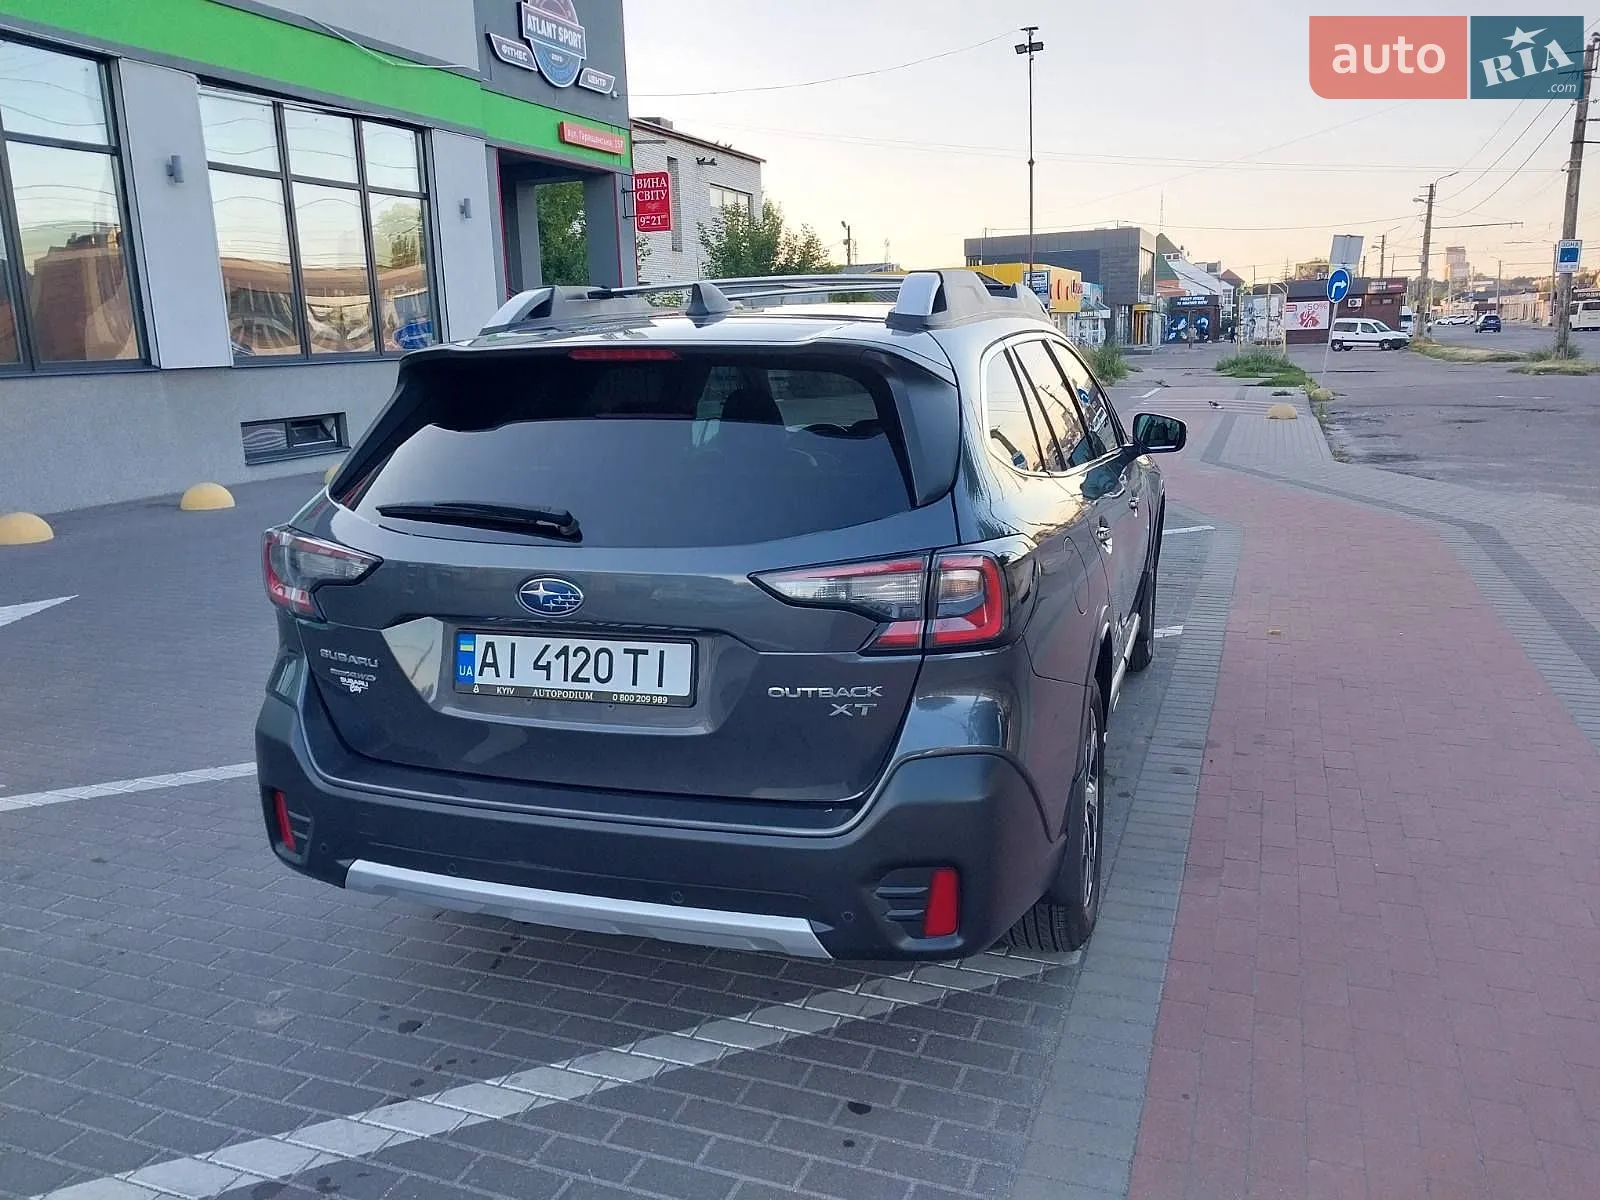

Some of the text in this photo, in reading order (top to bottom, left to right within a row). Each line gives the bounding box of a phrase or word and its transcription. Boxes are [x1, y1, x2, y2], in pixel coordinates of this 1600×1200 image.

[527, 13, 582, 49] ATLANT SPORT
[636, 177, 667, 189] ВИНА
[636, 189, 667, 201] СВІТУ
[320, 649, 379, 668] SUBARU
[478, 641, 665, 688] AI 4120 TI
[459, 665, 474, 677] UA
[340, 676, 369, 687] SUBARU
[496, 686, 515, 695] KYIV
[532, 688, 594, 701] AUTOPODIUM
[767, 686, 884, 698] OUTBACK
[612, 693, 668, 704] 0 800 209 989
[829, 703, 878, 717] XT
